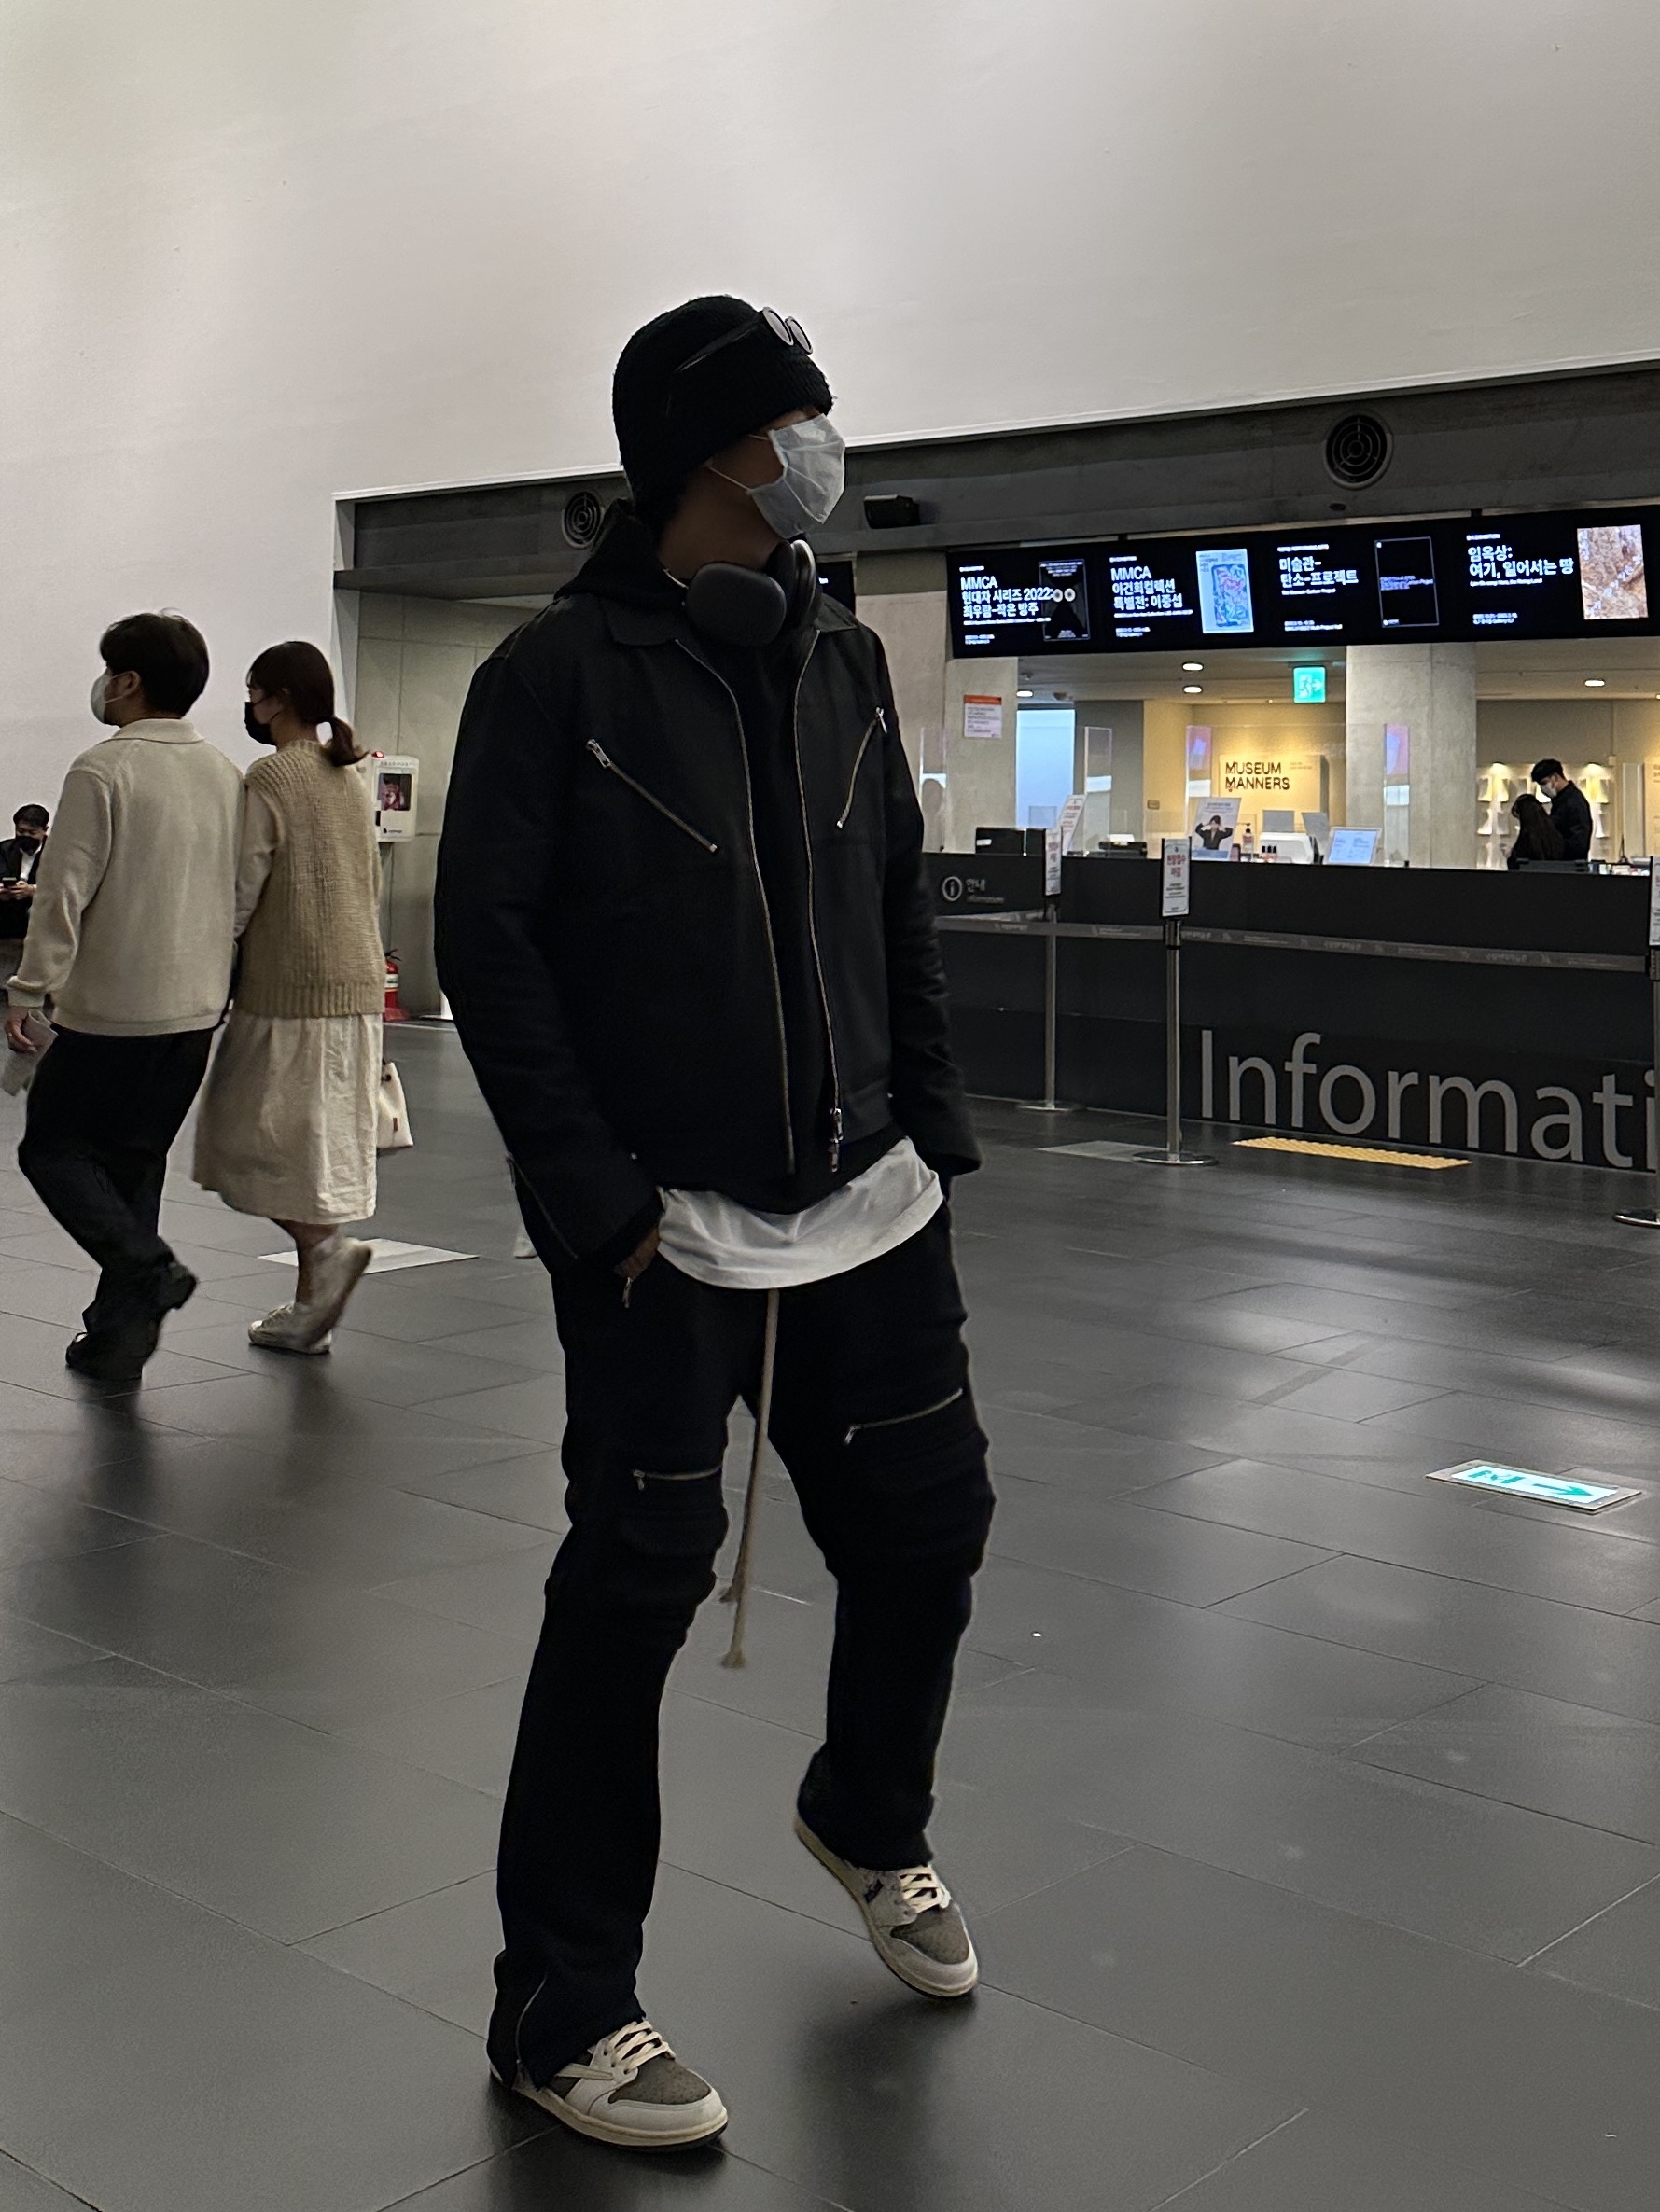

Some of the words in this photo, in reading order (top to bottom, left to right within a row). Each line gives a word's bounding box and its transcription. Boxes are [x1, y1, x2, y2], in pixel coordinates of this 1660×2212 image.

[1110, 565, 1152, 581] MMCA
[1469, 561, 1501, 579] 여기,
[1502, 559, 1557, 577] 일어서는
[1559, 557, 1574, 575] 땅
[960, 576, 998, 590] MMCA
[993, 588, 1023, 604] 시리즈
[1018, 602, 1039, 617] 방주
[1225, 761, 1282, 775] MUSEUM
[1225, 776, 1290, 791] MANNERS
